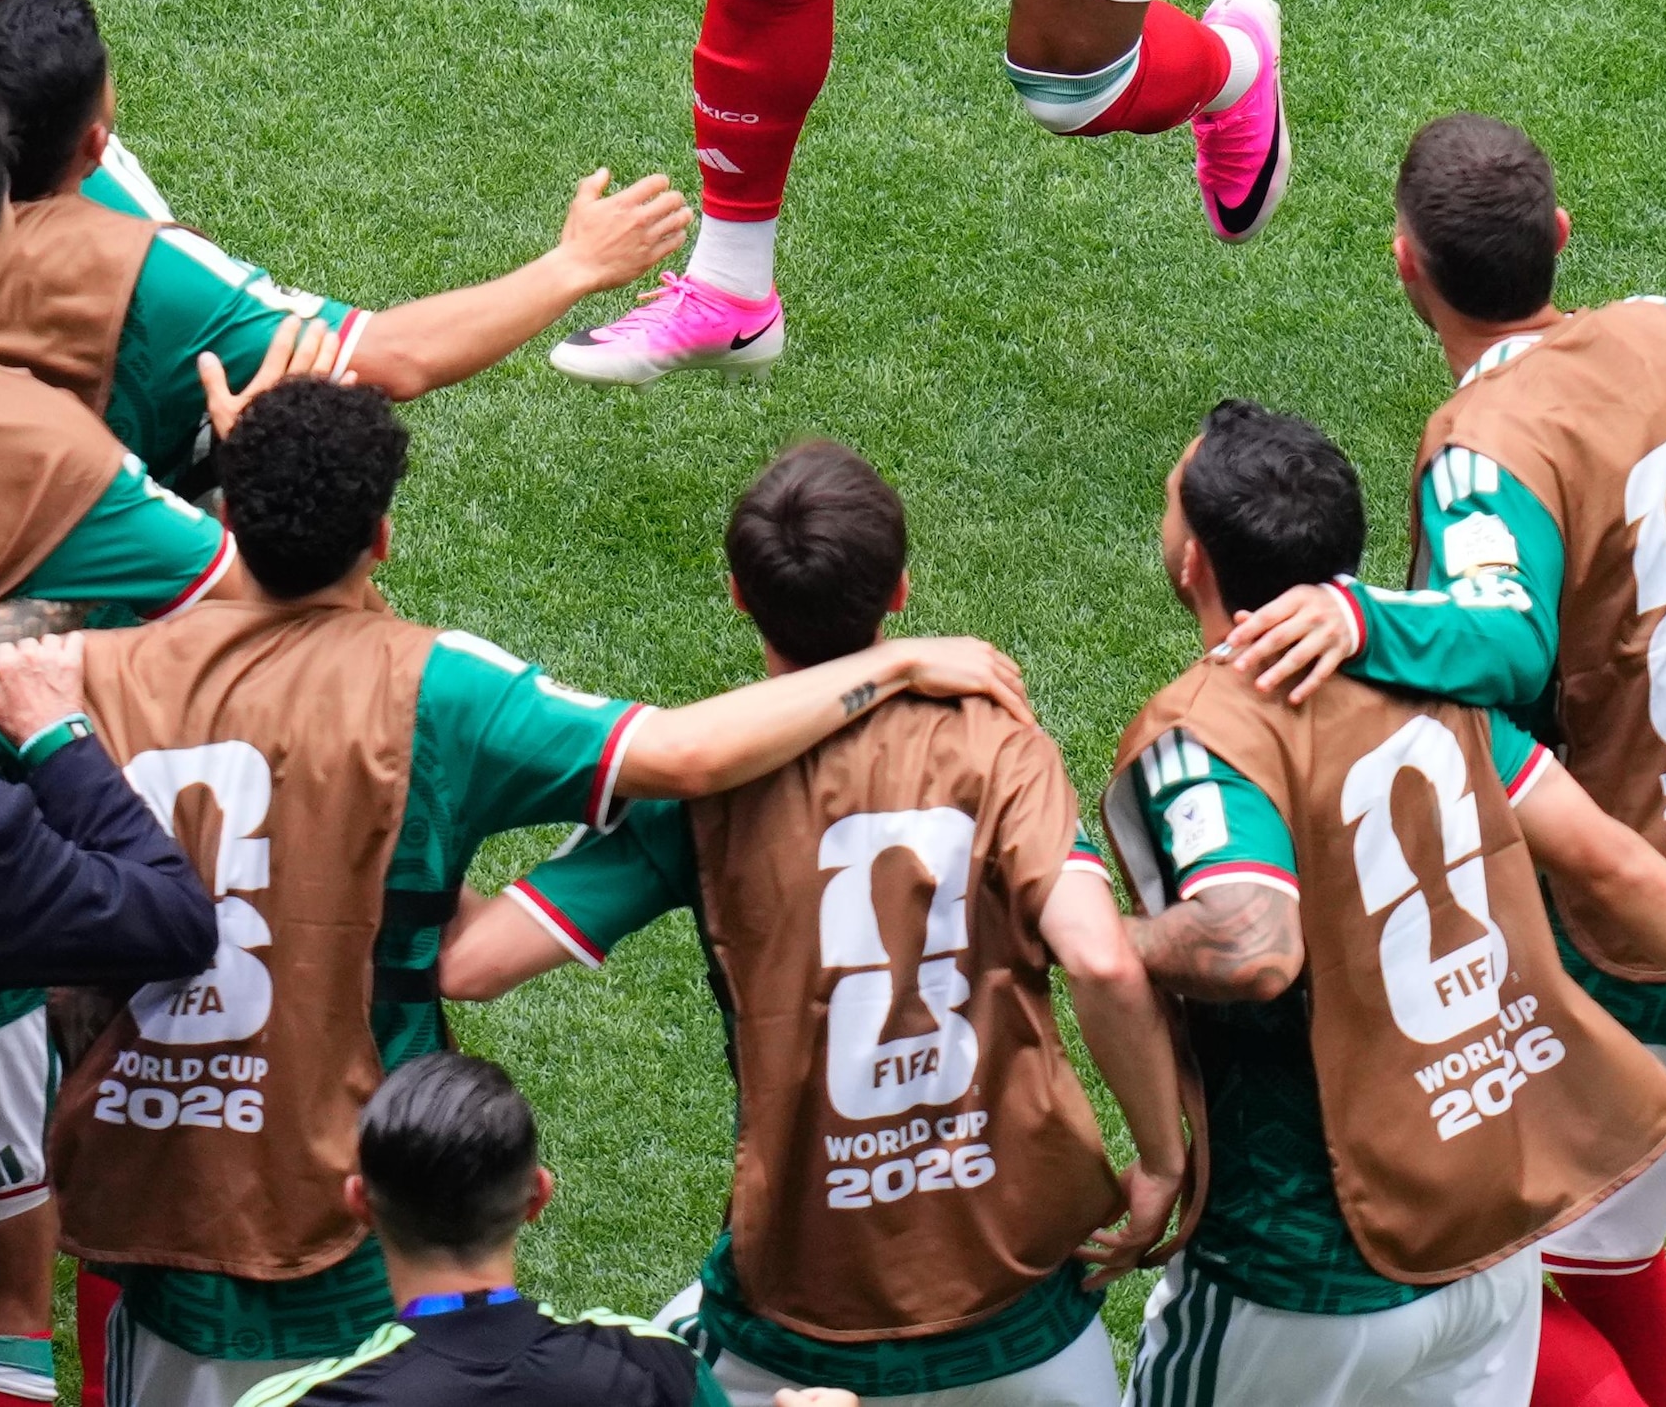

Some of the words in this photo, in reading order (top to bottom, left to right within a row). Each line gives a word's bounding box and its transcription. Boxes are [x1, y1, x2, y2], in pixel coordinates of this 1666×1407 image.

[694, 90, 759, 124] XICO
[167, 985, 225, 1017] IFA
[1434, 952, 1496, 1007] FIF
[208, 1053, 269, 1084] CUP
[873, 1047, 940, 1088] FIFA
[1413, 1027, 1507, 1094] WORL
[1498, 994, 1539, 1032] UP
[93, 1079, 265, 1134] 2026
[1429, 1025, 1566, 1142] 2026
[824, 1118, 932, 1163] WORLD
[934, 1110, 989, 1142] CUP
[825, 1143, 997, 1209] 2026
